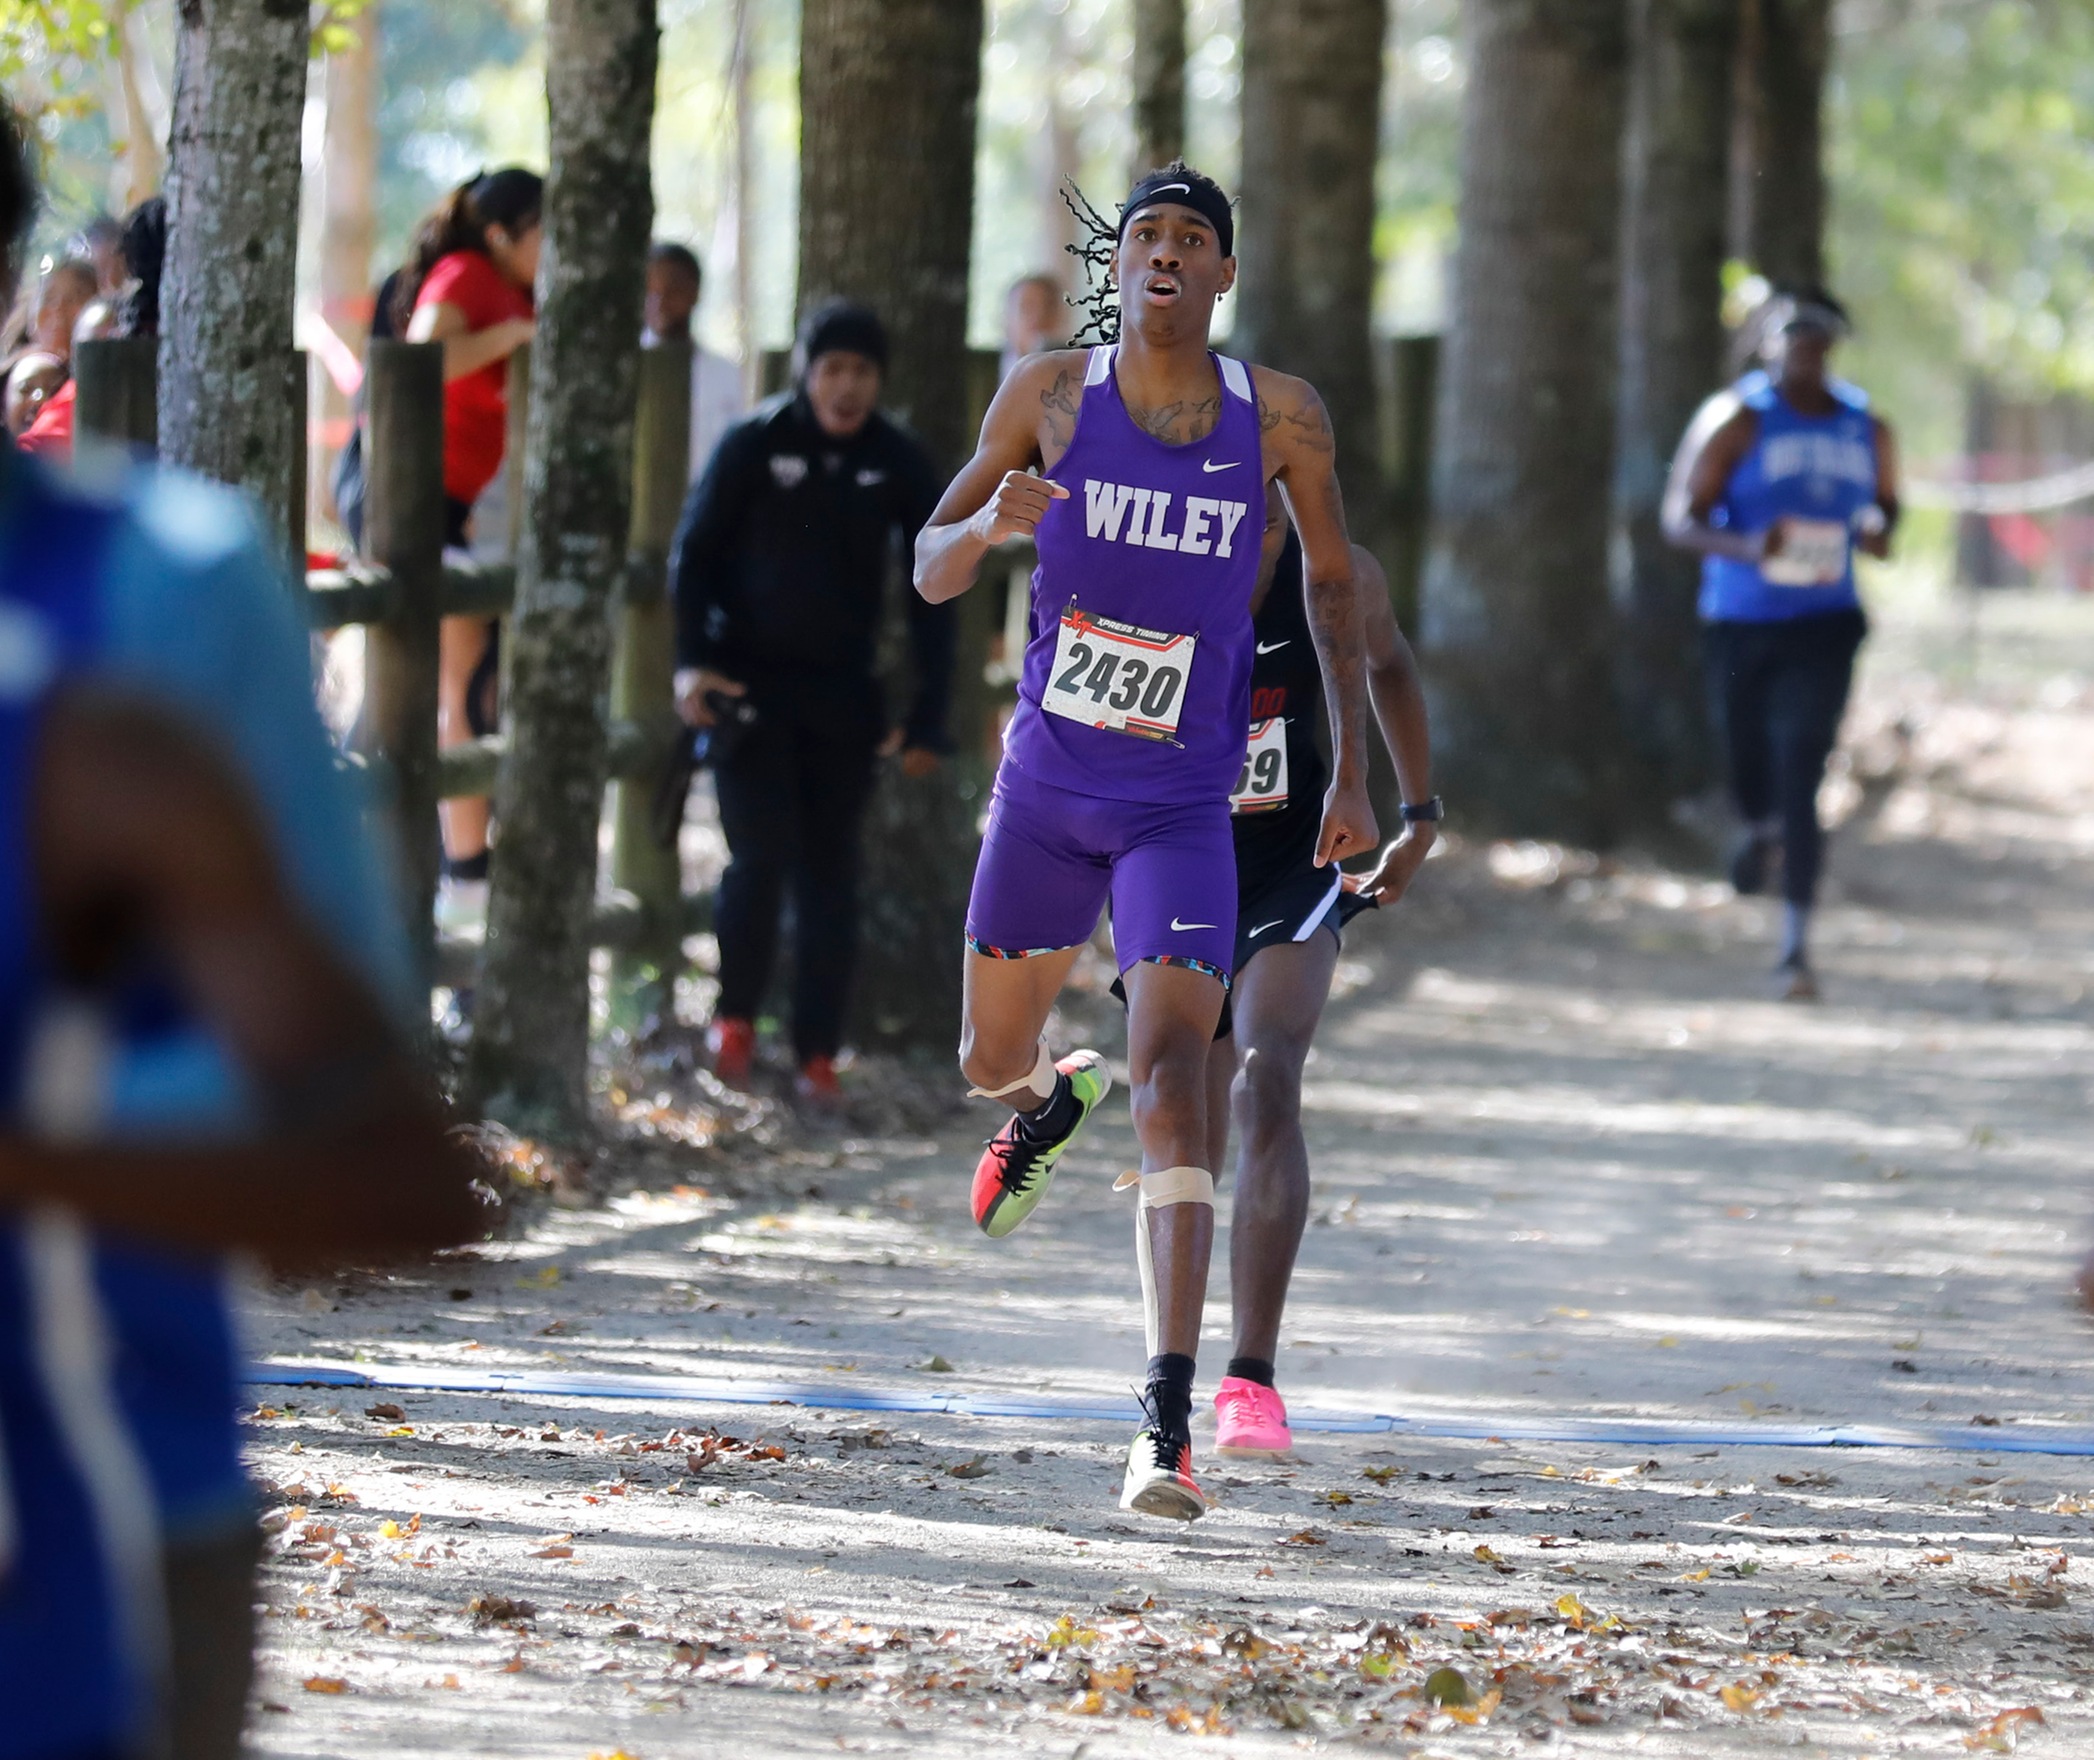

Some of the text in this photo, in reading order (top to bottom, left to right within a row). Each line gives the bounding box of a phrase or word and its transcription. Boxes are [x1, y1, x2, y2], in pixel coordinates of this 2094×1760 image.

[1084, 478, 1247, 558] WILEY
[1097, 617, 1135, 633] XPRESS
[1054, 642, 1182, 718] 2430
